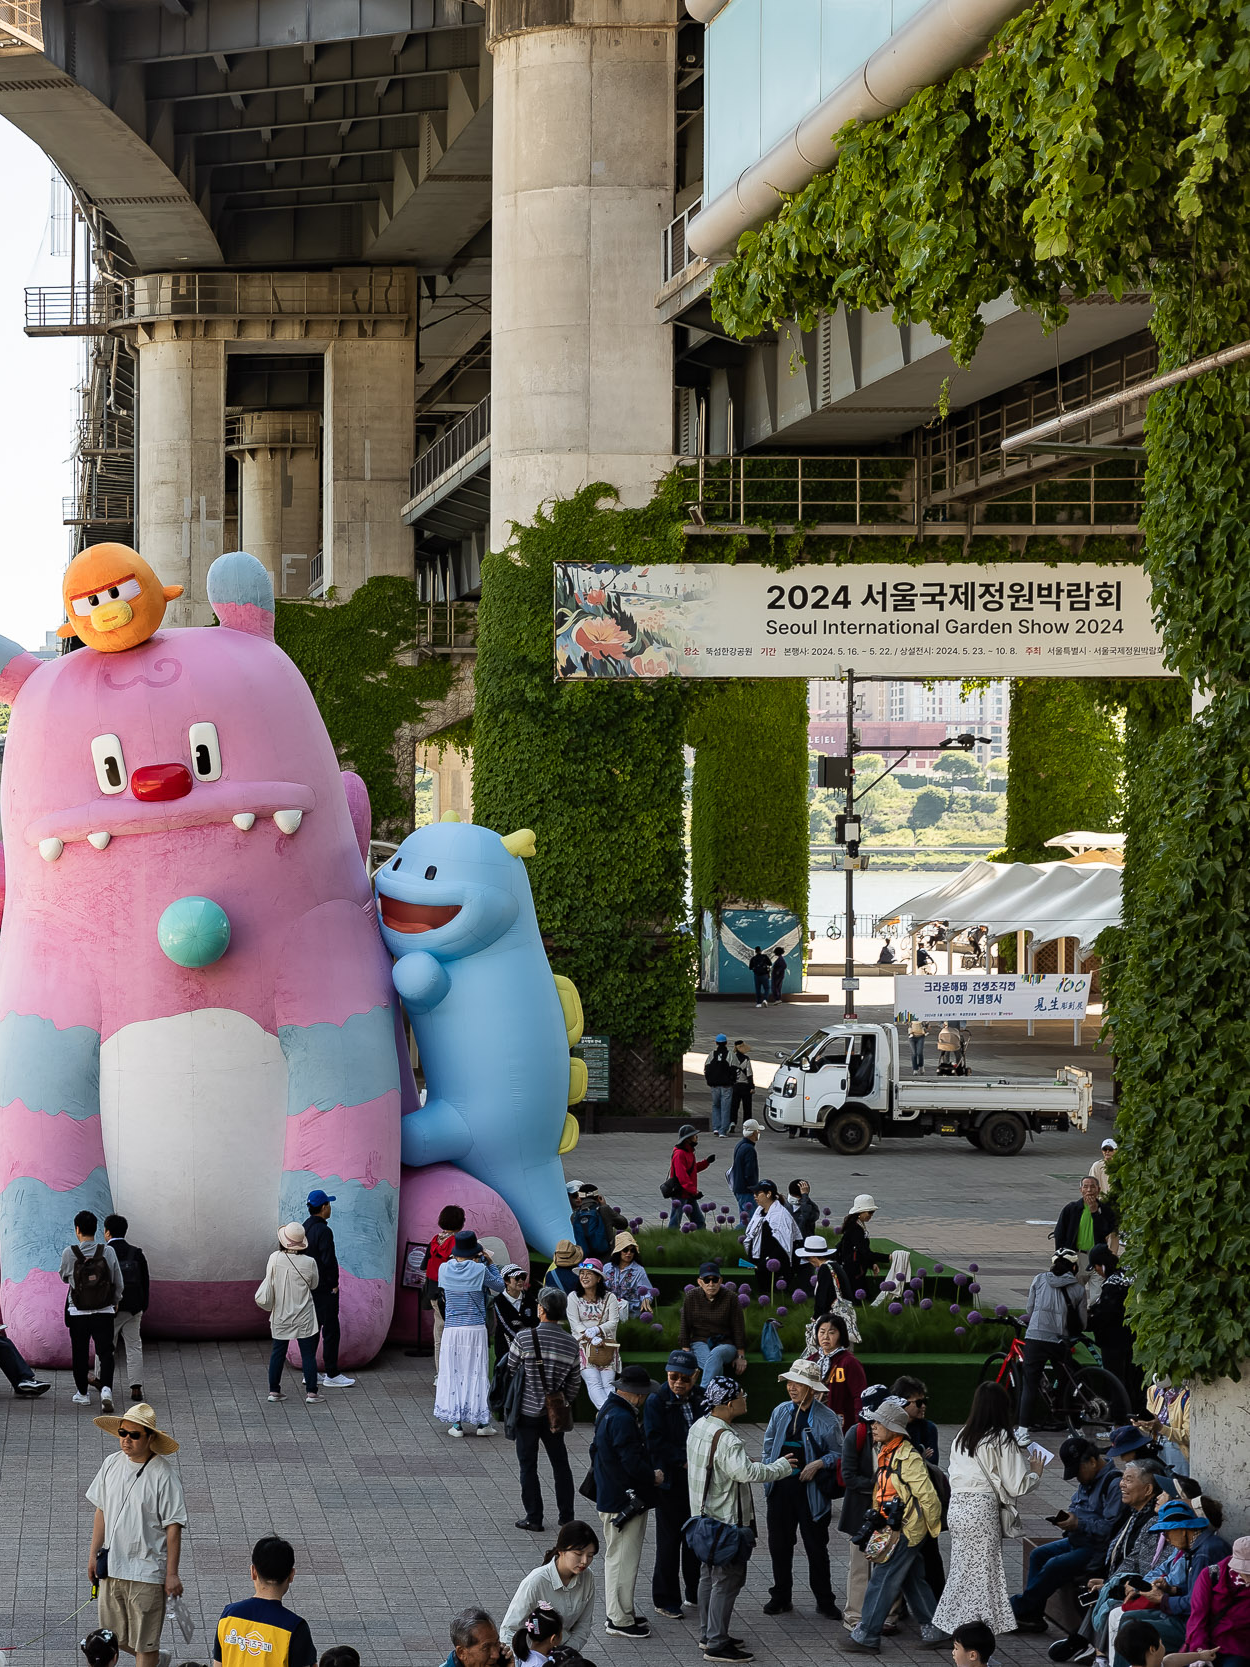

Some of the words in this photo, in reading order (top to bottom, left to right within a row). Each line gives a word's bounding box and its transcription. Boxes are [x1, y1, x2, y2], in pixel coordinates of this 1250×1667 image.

[766, 585, 852, 610] 2024
[860, 581, 1122, 612] 서울국제정원박람회
[766, 619, 817, 635] Seoul
[823, 619, 940, 635] International
[945, 619, 1012, 634] Garden
[1018, 619, 1069, 634] Show
[1075, 619, 1124, 634] 2024
[683, 647, 700, 656] 장소
[705, 647, 753, 656] 뚝섬한강공원
[760, 647, 776, 656] 기간
[783, 647, 810, 656] 본행사:
[811, 647, 835, 655] 2024.
[837, 647, 845, 655] 5.
[848, 647, 859, 655] 16.
[869, 647, 877, 655] 5.
[879, 647, 893, 655] 22.
[899, 647, 934, 656] 상설전시:
[936, 647, 960, 655] 2024.
[963, 647, 970, 655] 5.
[972, 647, 985, 655] 23.
[996, 647, 1007, 655] 10.
[1009, 647, 1017, 655] 8.
[1025, 647, 1041, 656] 주최
[1047, 647, 1087, 656] 서울특별시
[924, 981, 968, 992] 크라운해태
[1055, 977, 1086, 993] 100
[936, 994, 964, 1005] 100회
[967, 994, 1003, 1005] 기념행사
